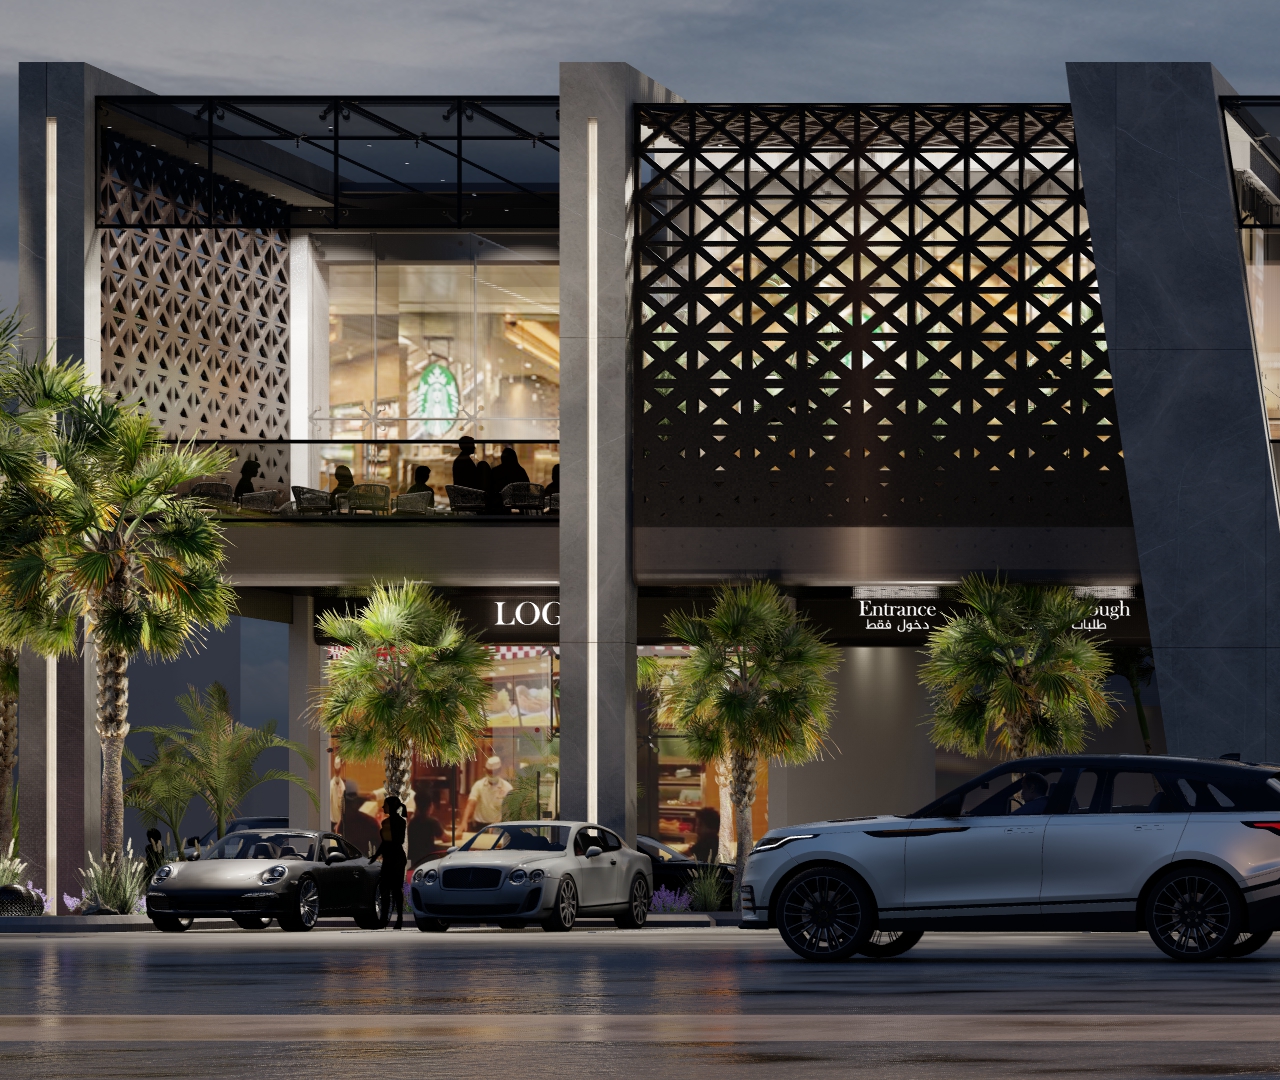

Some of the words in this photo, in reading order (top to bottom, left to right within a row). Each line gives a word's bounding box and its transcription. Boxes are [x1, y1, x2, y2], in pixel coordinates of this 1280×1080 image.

[494, 601, 560, 626] LOG
[859, 600, 937, 617] Entrance
[865, 619, 892, 630] فقط
[897, 619, 930, 633] دخول
